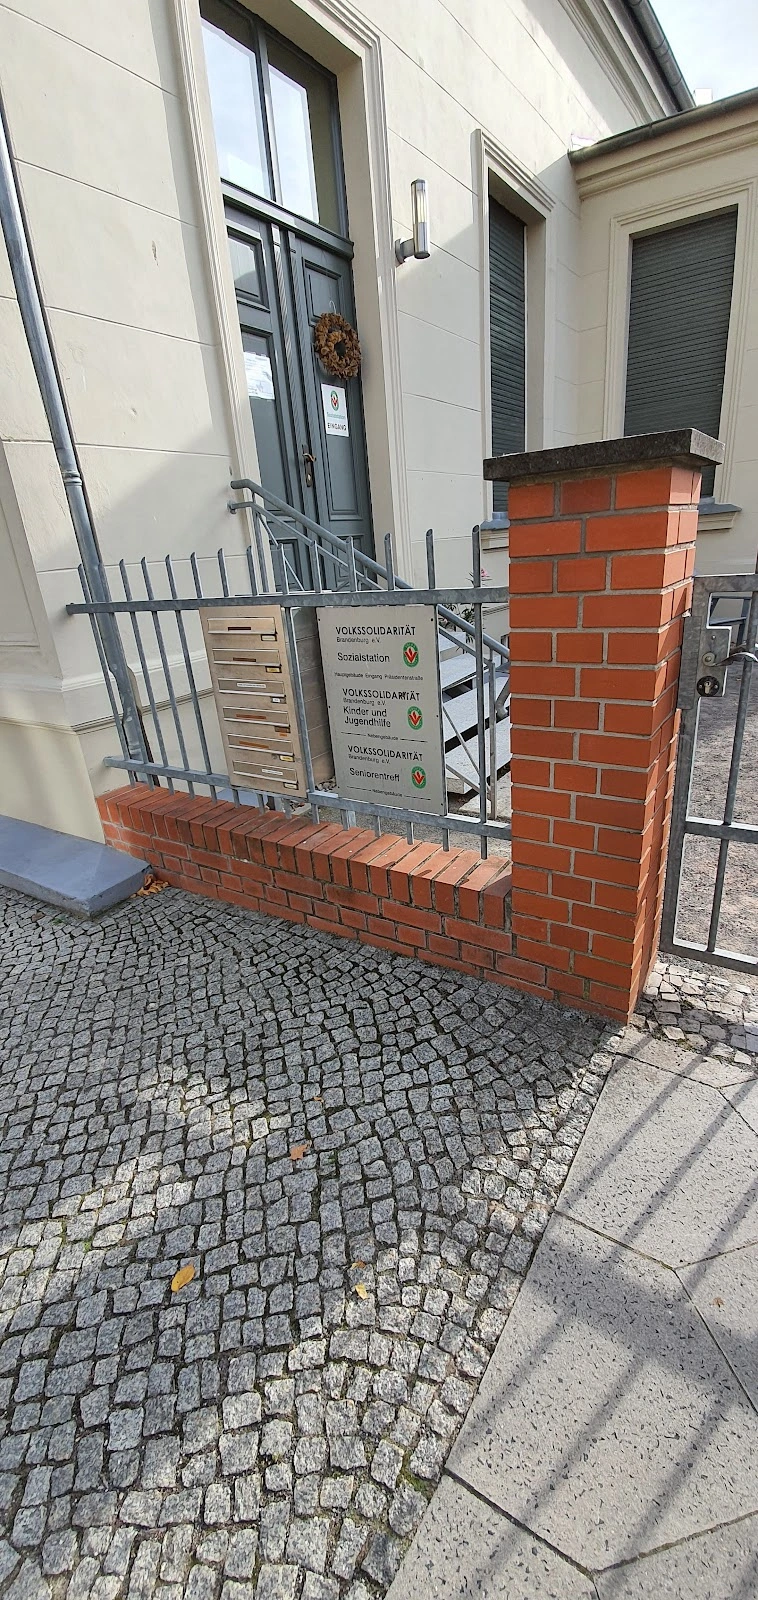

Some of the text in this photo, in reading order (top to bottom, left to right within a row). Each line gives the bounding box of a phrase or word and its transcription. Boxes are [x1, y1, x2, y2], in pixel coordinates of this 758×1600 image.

[335, 624, 416, 636] VOLKSSOLIDARITÄT
[336, 636, 369, 644] Brandenburg
[337, 652, 390, 662] Sozialstation
[343, 697, 374, 706] Brandenburg
[343, 706, 387, 717] Kinder und
[344, 716, 391, 728] Jugendhilfe
[347, 745, 423, 761] VOLKSSOLIDARITÄT
[348, 753, 379, 764] Brandenburg
[349, 767, 400, 782] Seniorentreff
